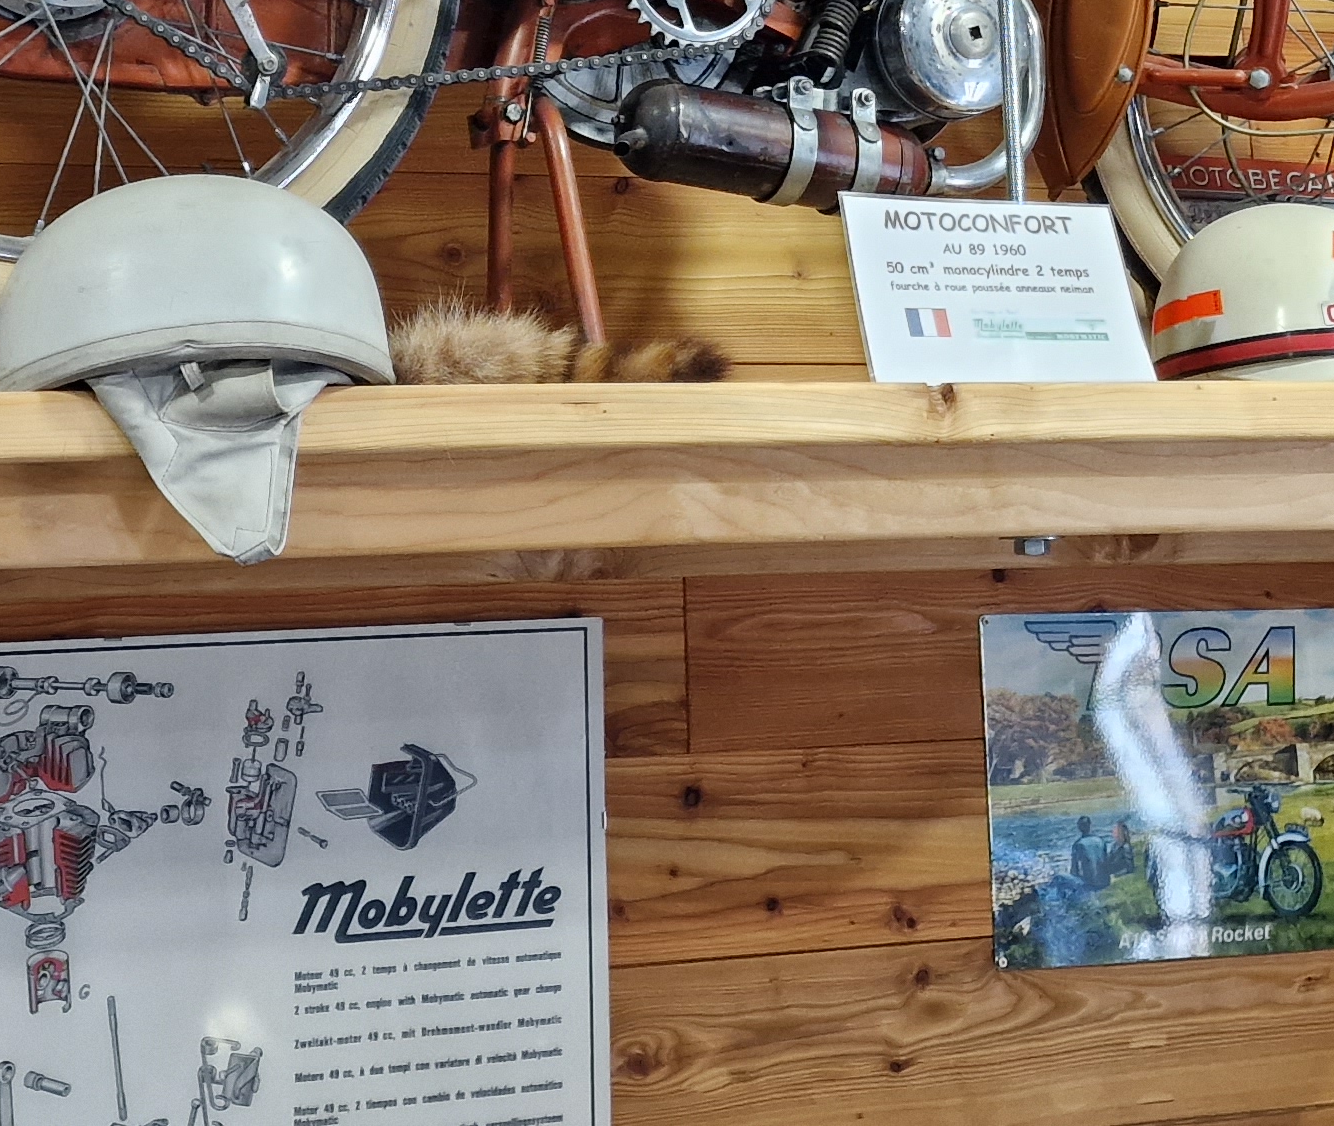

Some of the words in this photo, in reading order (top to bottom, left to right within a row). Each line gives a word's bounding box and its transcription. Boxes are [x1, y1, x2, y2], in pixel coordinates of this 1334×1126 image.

[884, 209, 1072, 235] MOTOCONFORT
[943, 243, 962, 255] AU
[968, 243, 986, 255] 89
[993, 244, 1027, 256] 1960
[886, 261, 904, 274] 50
[910, 261, 935, 275] cm³
[943, 263, 1030, 280] monocylindre
[1035, 265, 1044, 276] 2
[1051, 267, 1090, 281] temps
[890, 281, 930, 291] fourche
[934, 281, 941, 291] à
[944, 283, 967, 292] roue
[972, 282, 1012, 294] poussée
[1015, 284, 1057, 293] anneaux
[1060, 284, 1094, 294] neiman
[292, 866, 562, 944] Mobylette
[1211, 923, 1271, 943] Rocket
[329, 968, 340, 978] 49
[361, 965, 367, 975] 2
[78, 983, 91, 1001] G
[294, 1006, 300, 1016] 2
[335, 1001, 346, 1011] 49
[368, 1030, 379, 1042] 49
[517, 1014, 563, 1028] Mobymatic
[329, 1069, 340, 1080] 49
[355, 1100, 361, 1111] 2
